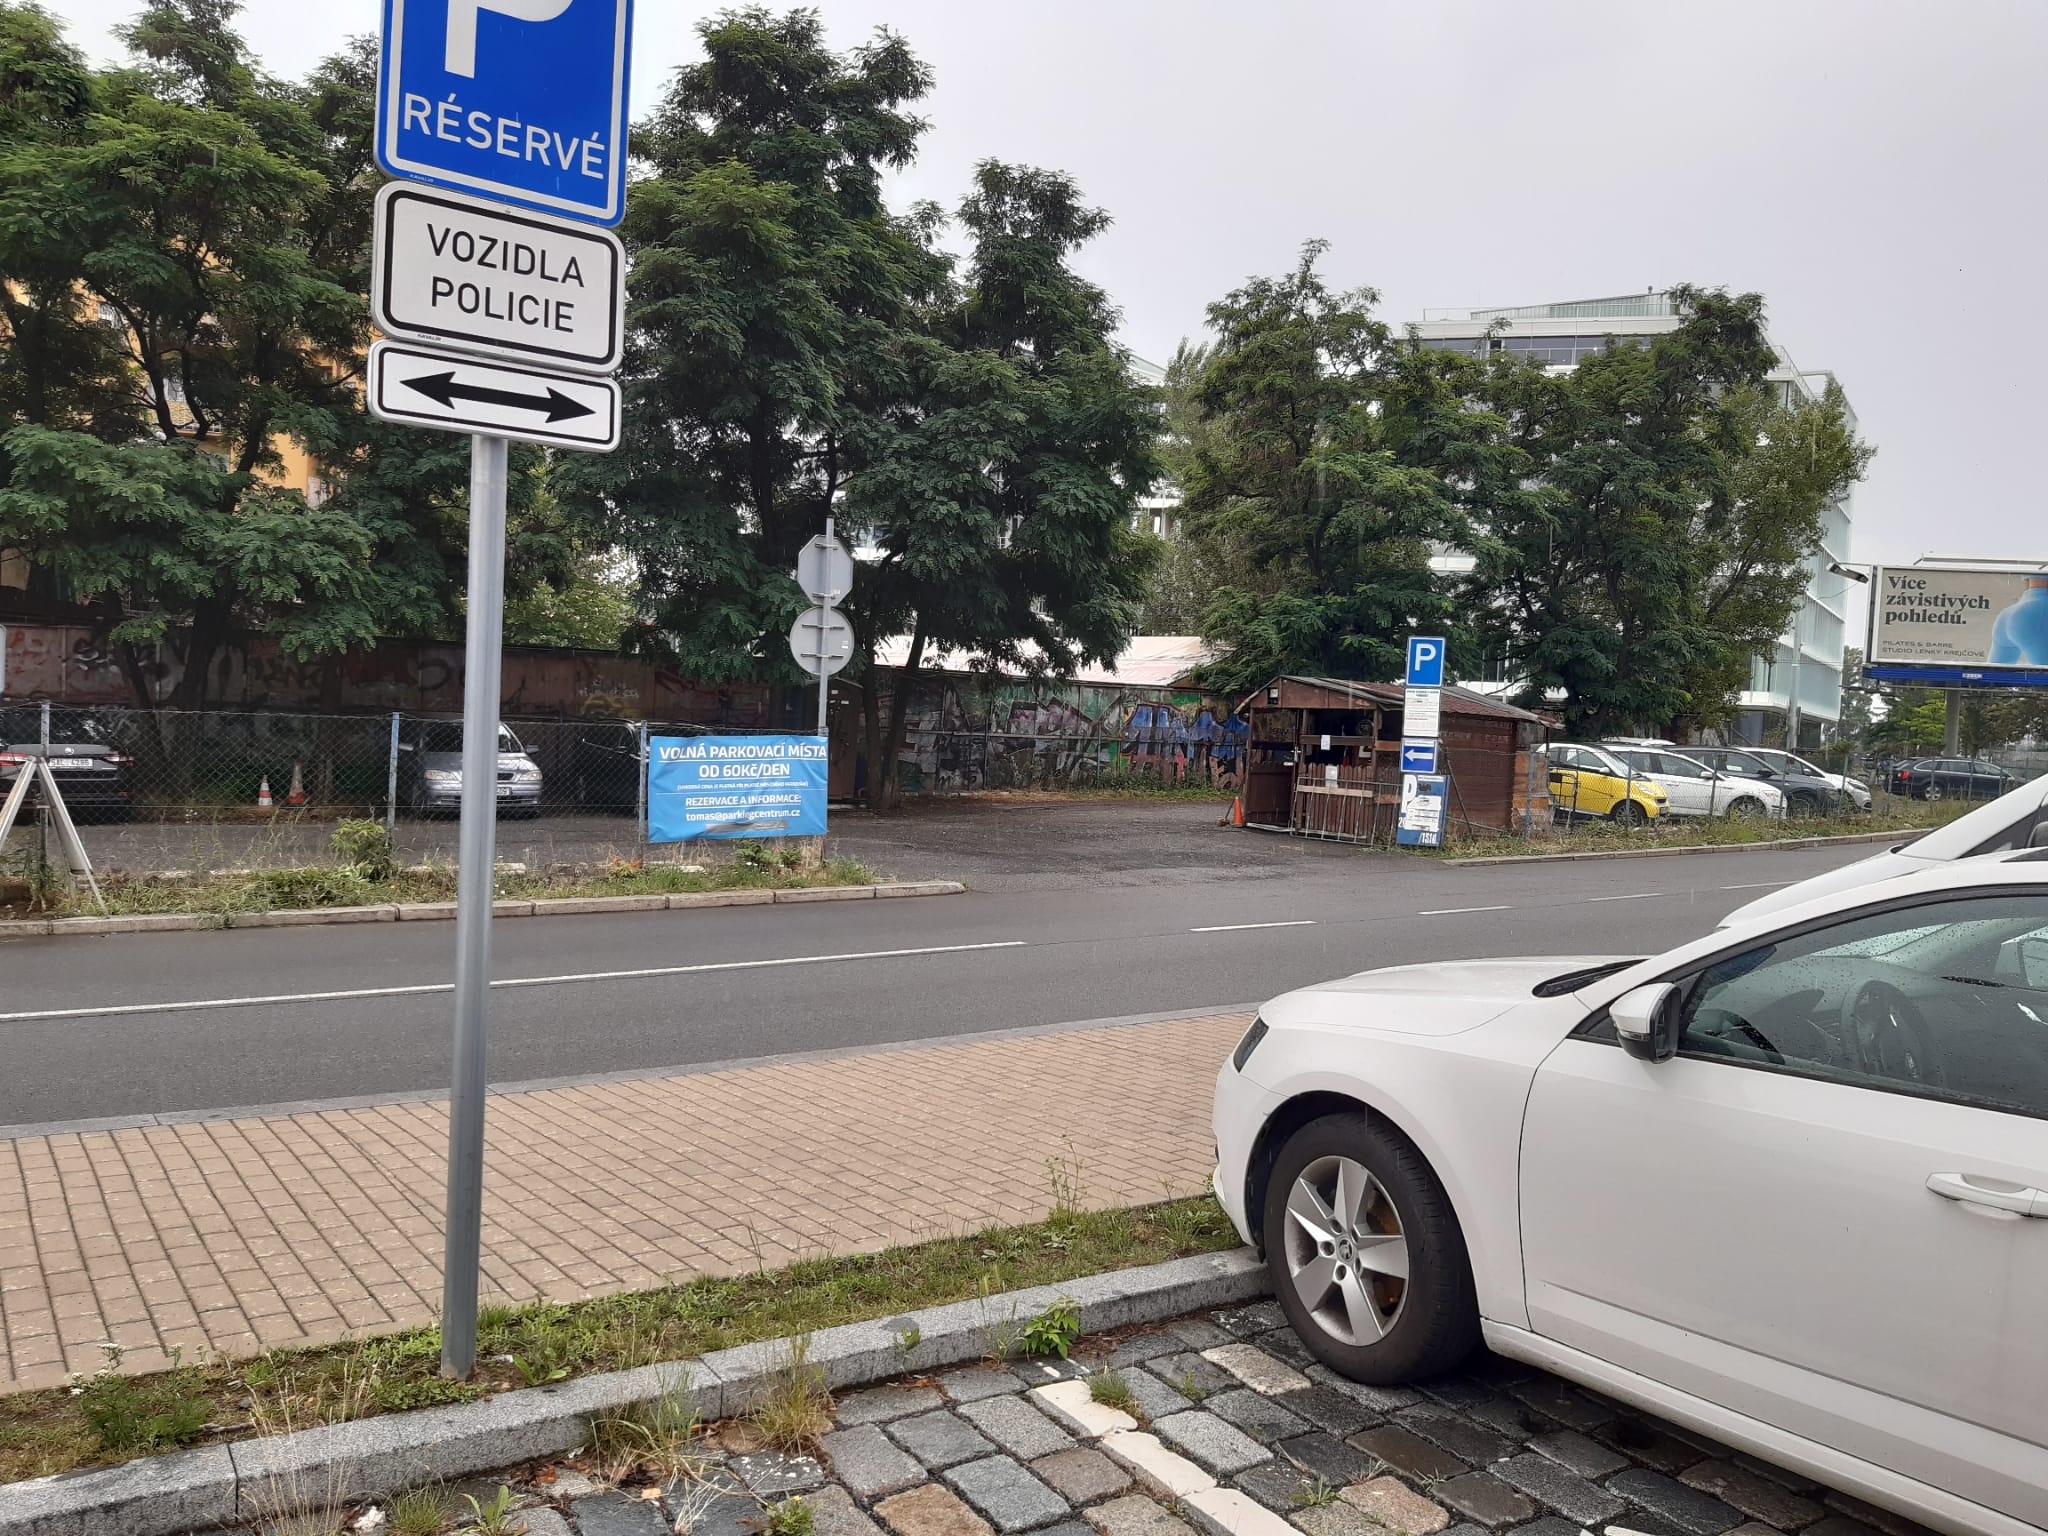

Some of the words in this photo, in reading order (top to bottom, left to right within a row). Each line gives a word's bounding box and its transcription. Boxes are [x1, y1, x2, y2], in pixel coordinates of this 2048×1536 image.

[403, 92, 605, 180] RÉSERVÉ
[427, 223, 585, 289] VOZIDLA
[431, 276, 575, 333] POLICIE
[1888, 576, 1927, 590] Více
[1886, 592, 1990, 611] závistivých
[1885, 609, 1967, 625] pohledů.
[1414, 643, 1437, 671] P
[660, 743, 707, 759] VOLNÁ
[710, 742, 785, 758] PARKOVACÍ
[788, 742, 827, 757] MÍSTA
[699, 765, 720, 778] OD
[723, 763, 790, 778] 60Kč/DEN
[685, 796, 739, 807] REZERVACE
[686, 809, 801, 821] tomas@parkingcentrum.cz
